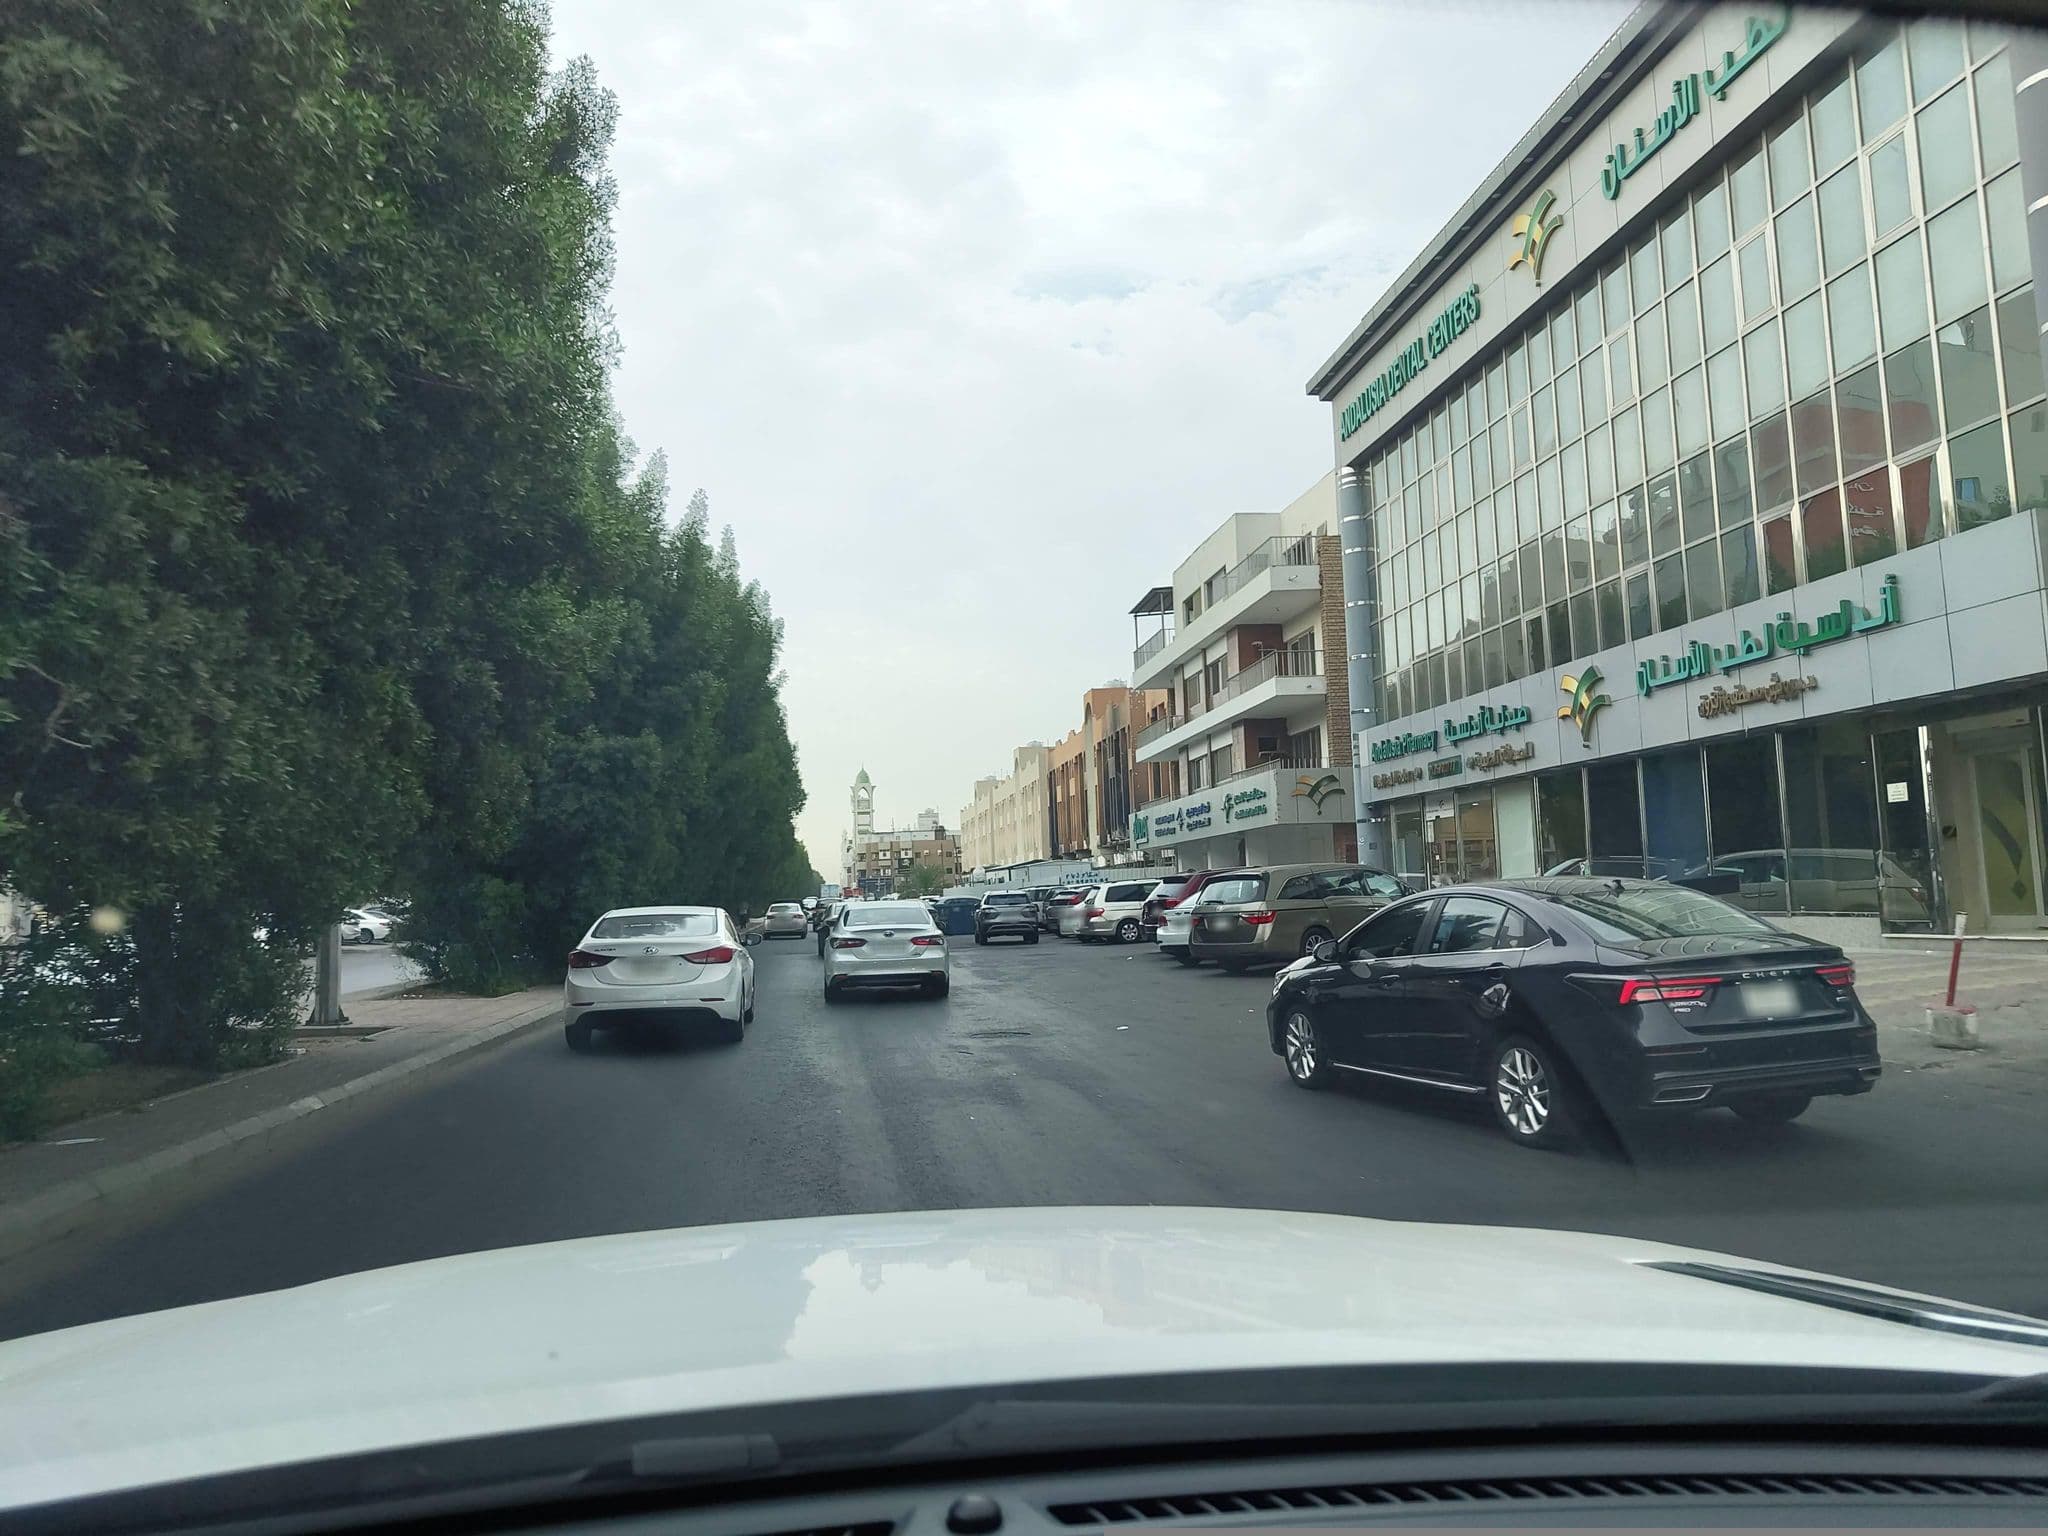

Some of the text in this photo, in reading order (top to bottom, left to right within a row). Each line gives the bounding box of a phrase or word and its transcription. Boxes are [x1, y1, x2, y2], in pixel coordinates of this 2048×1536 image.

[1601, 73, 1700, 200] الأسنان
[1340, 283, 1481, 442] ANDALUSIA DENTAL CENTERS
[1636, 639, 1712, 697] الأسنان
[1713, 623, 1775, 676] لطب
